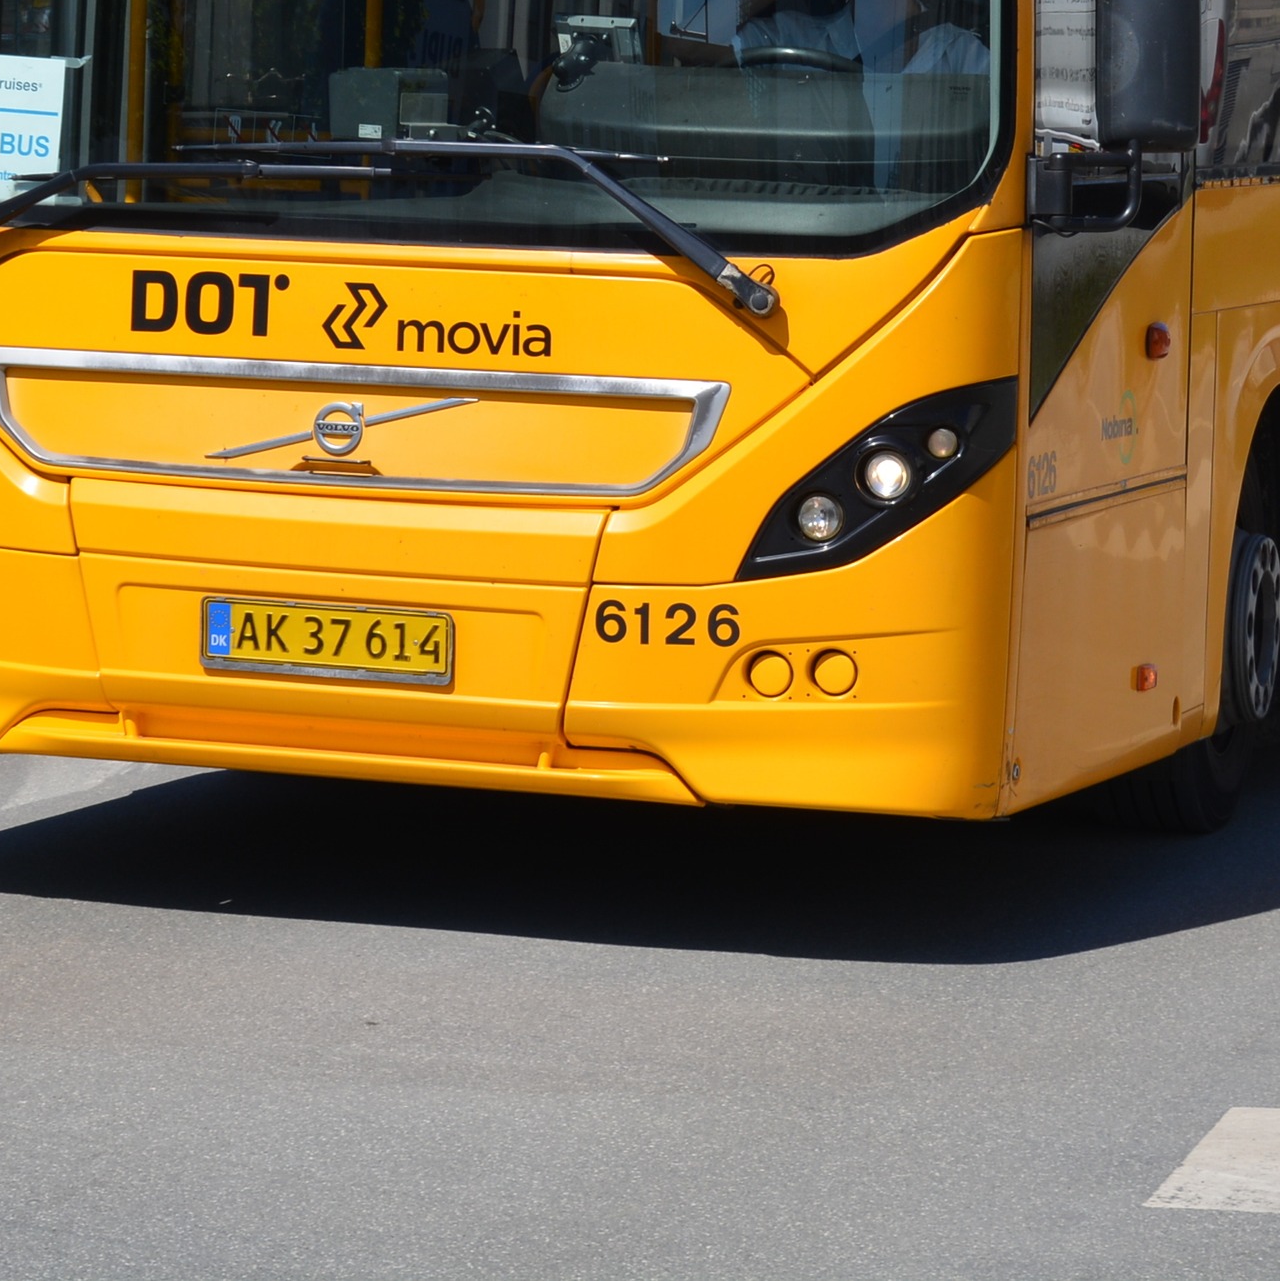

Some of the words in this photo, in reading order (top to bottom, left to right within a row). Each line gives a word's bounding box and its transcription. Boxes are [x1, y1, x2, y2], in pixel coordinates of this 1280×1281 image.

[0, 133, 49, 157] BUS
[131, 270, 270, 336] DOT
[397, 310, 551, 358] movia
[316, 423, 360, 433] VOLVO
[1027, 451, 1057, 498] 6126
[210, 633, 228, 648] DK
[235, 612, 289, 653] AK
[301, 617, 352, 656] 37
[364, 623, 442, 664] 614
[594, 599, 741, 648] 6126
